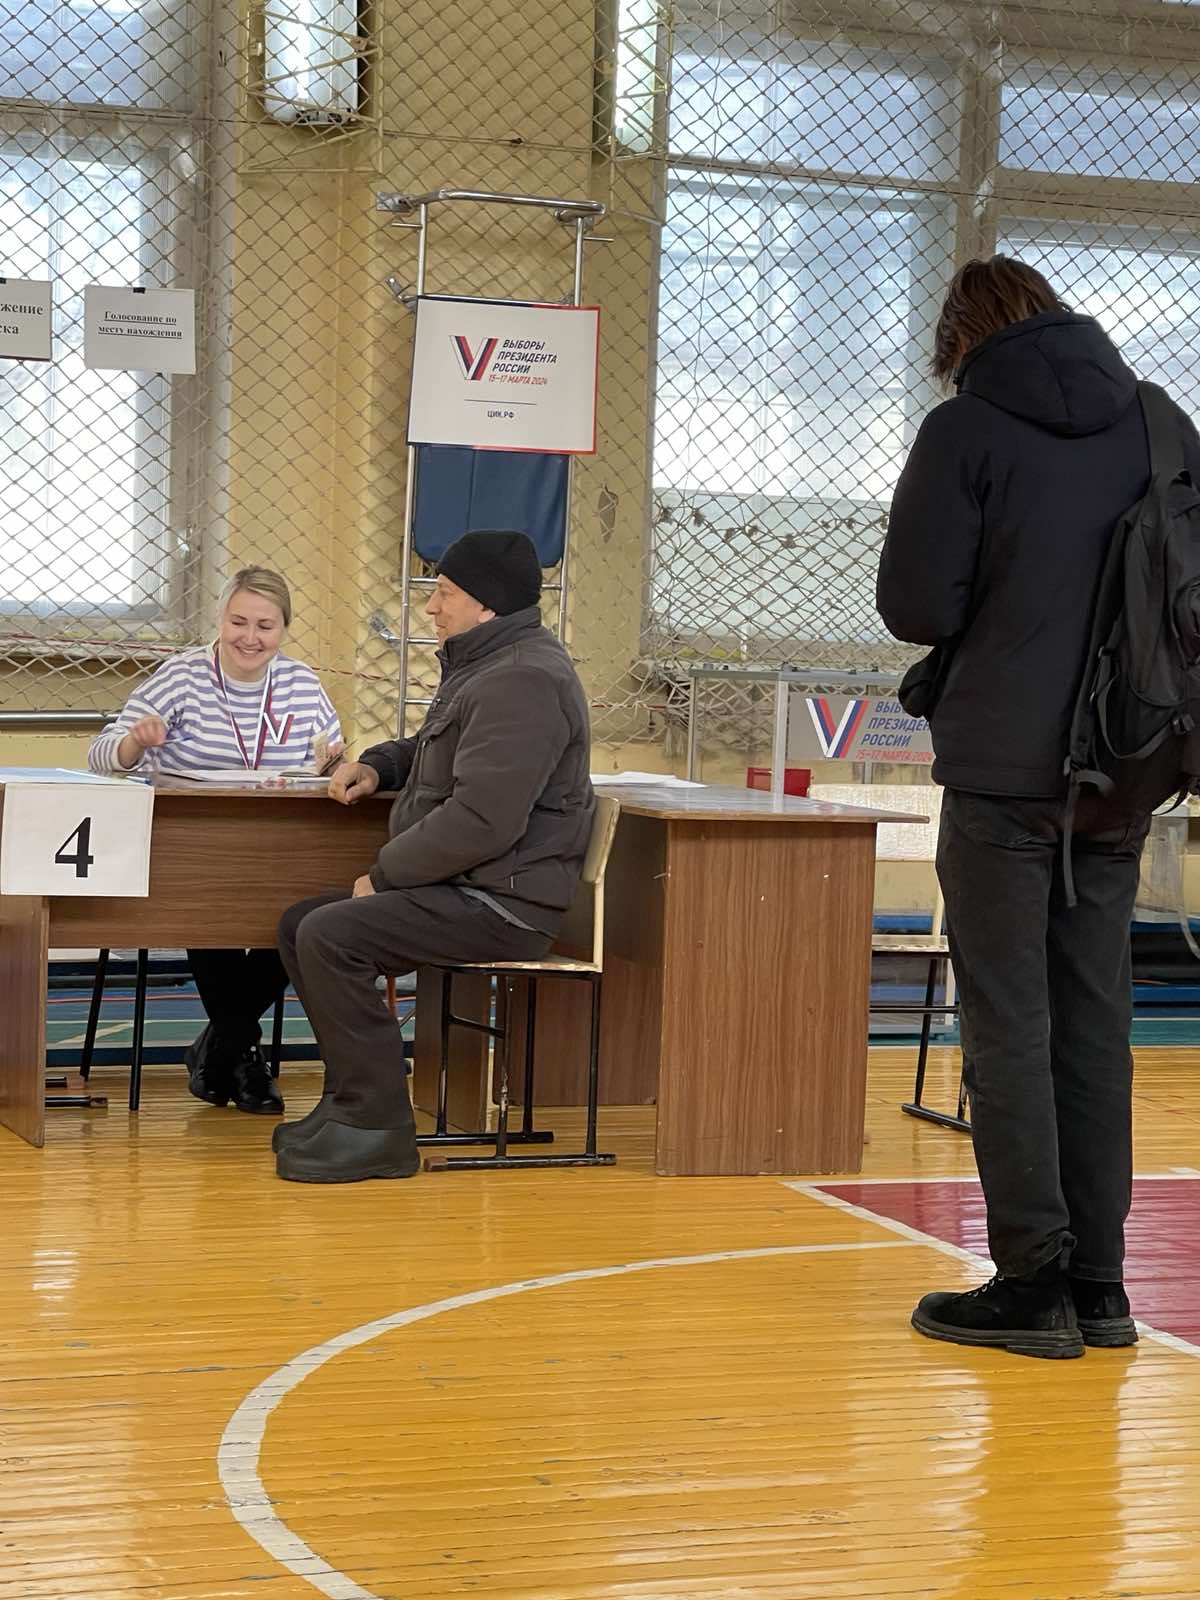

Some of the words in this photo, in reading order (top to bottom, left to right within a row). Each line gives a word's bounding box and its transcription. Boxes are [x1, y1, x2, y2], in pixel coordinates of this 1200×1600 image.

[0, 303, 44, 316] жение
[104, 311, 164, 323] Голосование
[165, 316, 177, 324] по
[98, 326, 124, 334] месту
[127, 327, 182, 338] нахождения
[502, 339, 546, 351] ВЫБОРЫ
[497, 351, 558, 364] ПРЕЗИДЕНТА
[492, 362, 531, 374] РОССИИ
[507, 375, 531, 385] МАРТА
[875, 701, 904, 713] ВЫБ
[861, 733, 912, 747] РОССИИ
[55, 817, 94, 878] 4
